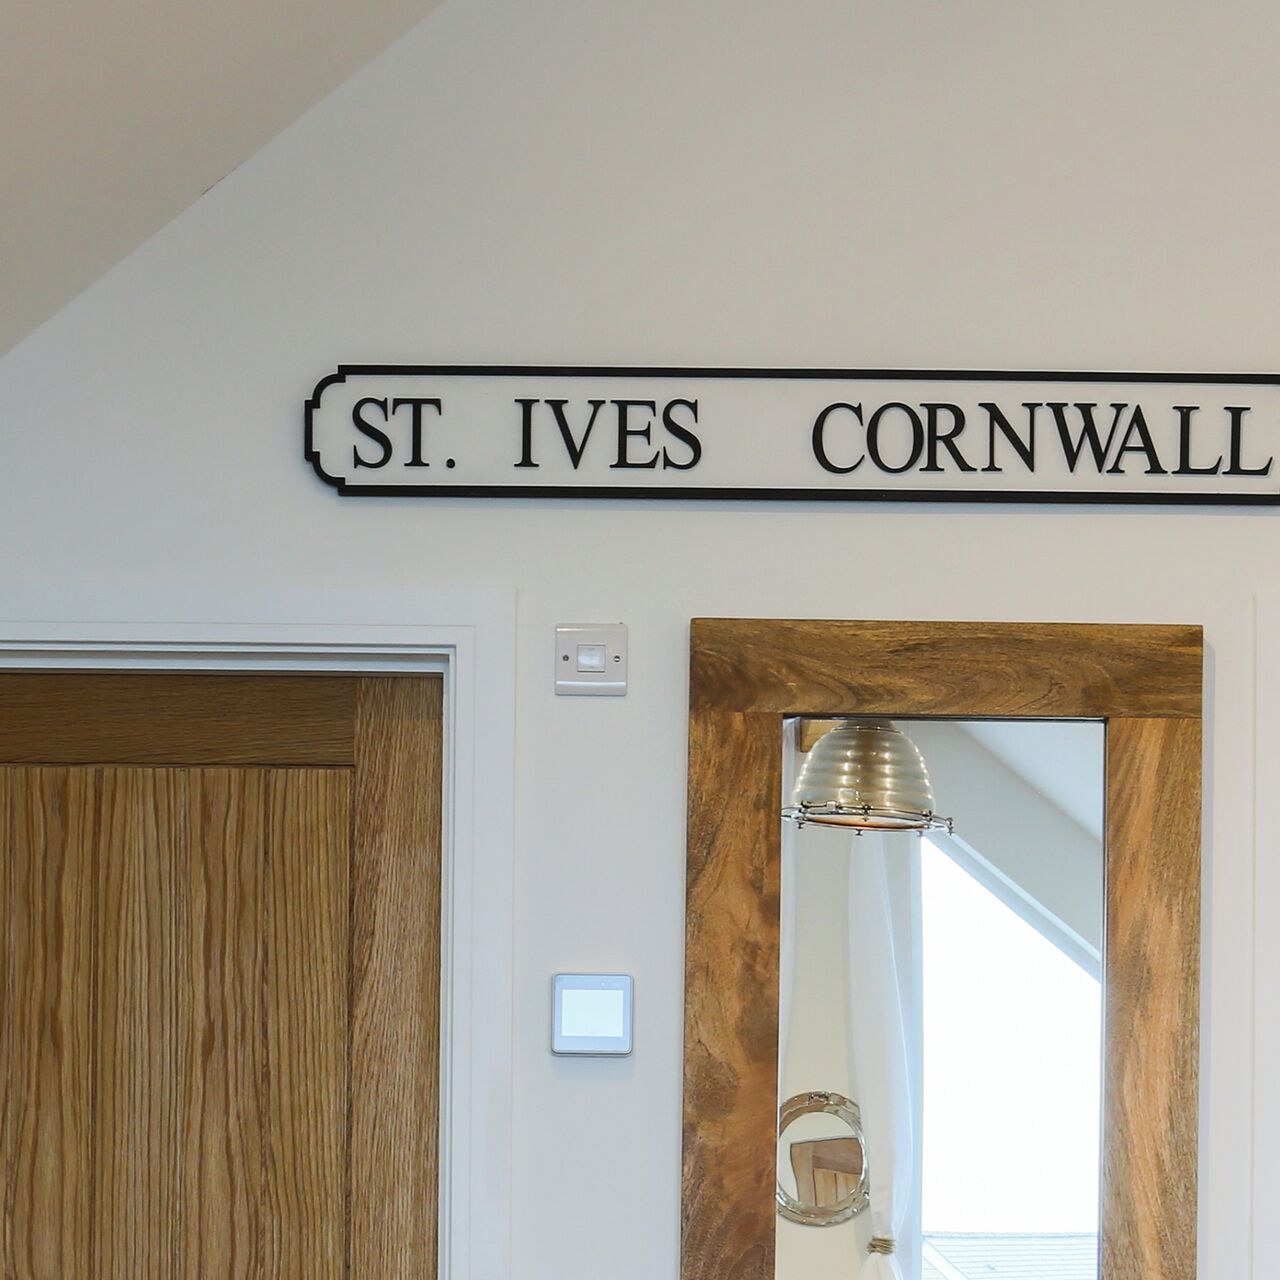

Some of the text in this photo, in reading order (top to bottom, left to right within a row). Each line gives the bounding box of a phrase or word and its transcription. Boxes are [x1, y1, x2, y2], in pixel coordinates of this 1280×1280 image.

[352, 397, 1273, 477] ST. IVES CORNWALL
